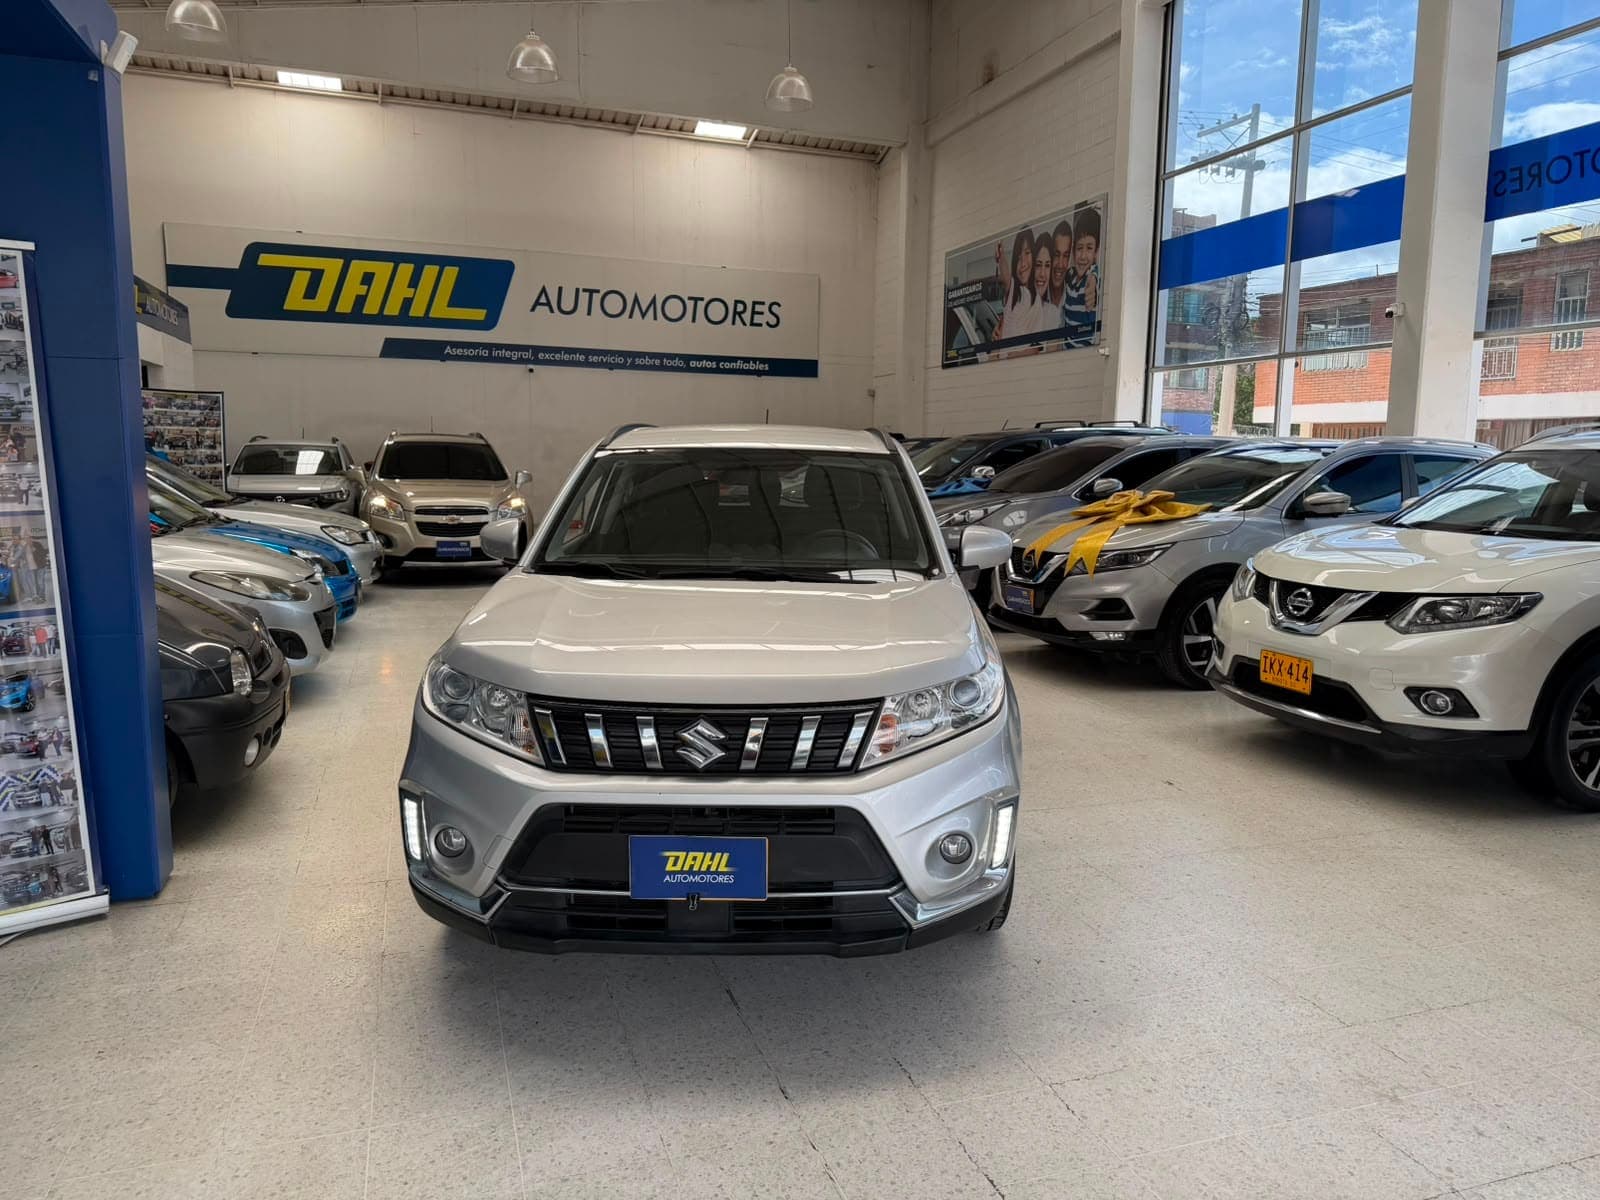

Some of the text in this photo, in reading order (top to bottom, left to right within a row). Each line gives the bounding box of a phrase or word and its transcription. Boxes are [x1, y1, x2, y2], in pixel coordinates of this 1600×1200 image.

[257, 253, 488, 321] DAHL
[529, 283, 782, 329] AUTOMOTORES
[444, 345, 769, 371] Asesoría integral, excelente servicio y sobre todo, autos confiables
[1262, 656, 1285, 677] IKX
[1287, 662, 1309, 683] 414
[660, 851, 738, 872] DAHL
[663, 873, 735, 884] AUTOMOTORES
